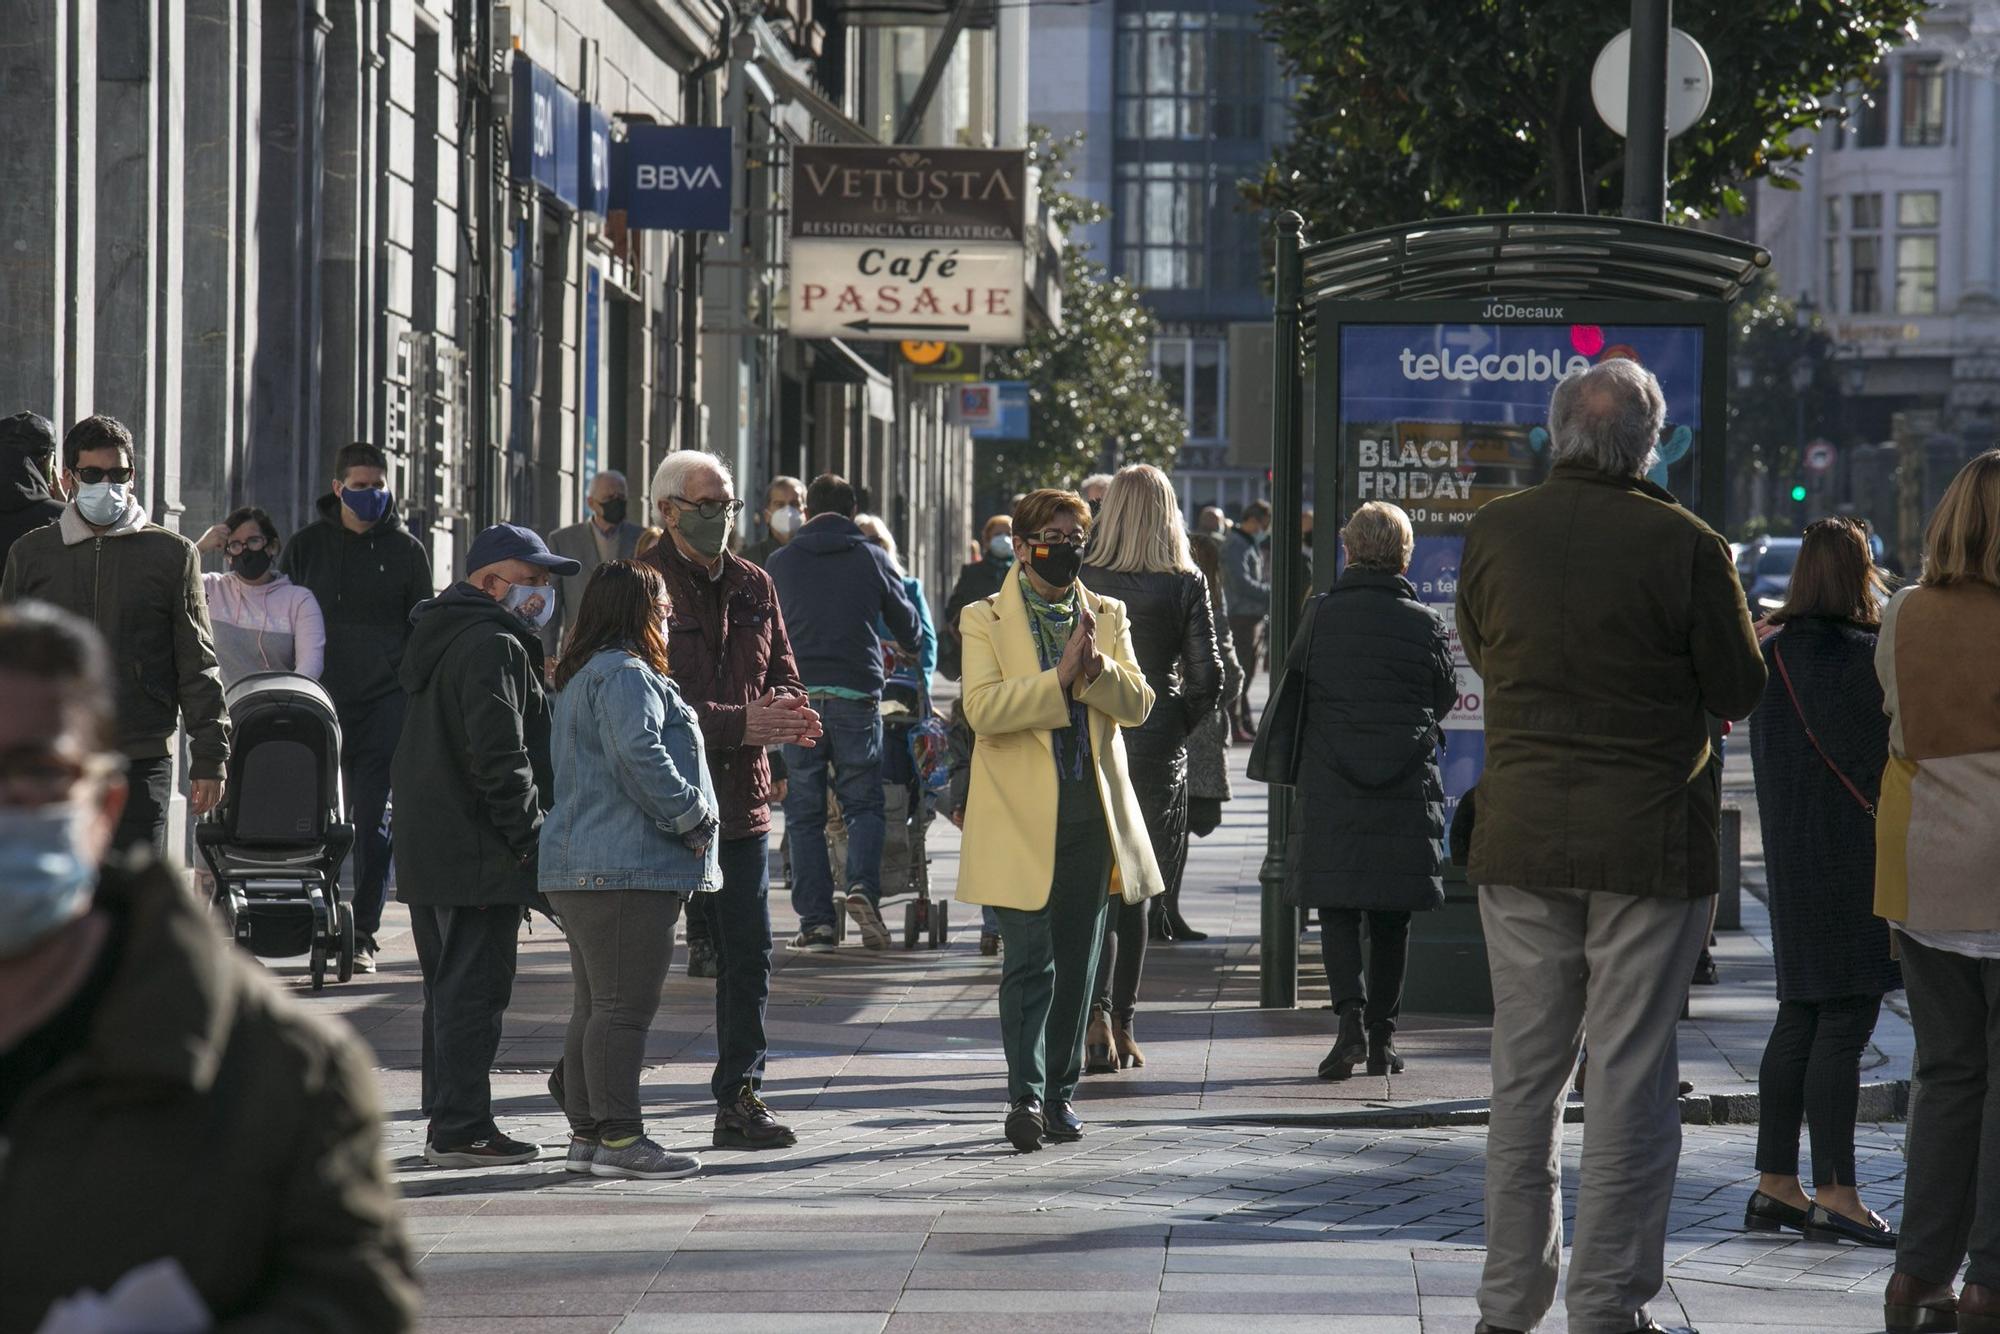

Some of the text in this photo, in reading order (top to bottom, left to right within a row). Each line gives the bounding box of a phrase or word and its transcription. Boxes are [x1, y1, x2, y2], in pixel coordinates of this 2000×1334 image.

[637, 164, 722, 190] BBVA
[803, 163, 1016, 201] VETUSTA
[802, 221, 1013, 239] RESIDENCIA GERIATRICA
[857, 248, 959, 283] Café
[801, 283, 1012, 317] PASAJE
[1482, 304, 1564, 319] JCDecaux
[1399, 347, 1590, 382] telecable
[1358, 471, 1477, 500] FRIDAY
[1431, 512, 1444, 522] DE
[1422, 581, 1433, 593] a
